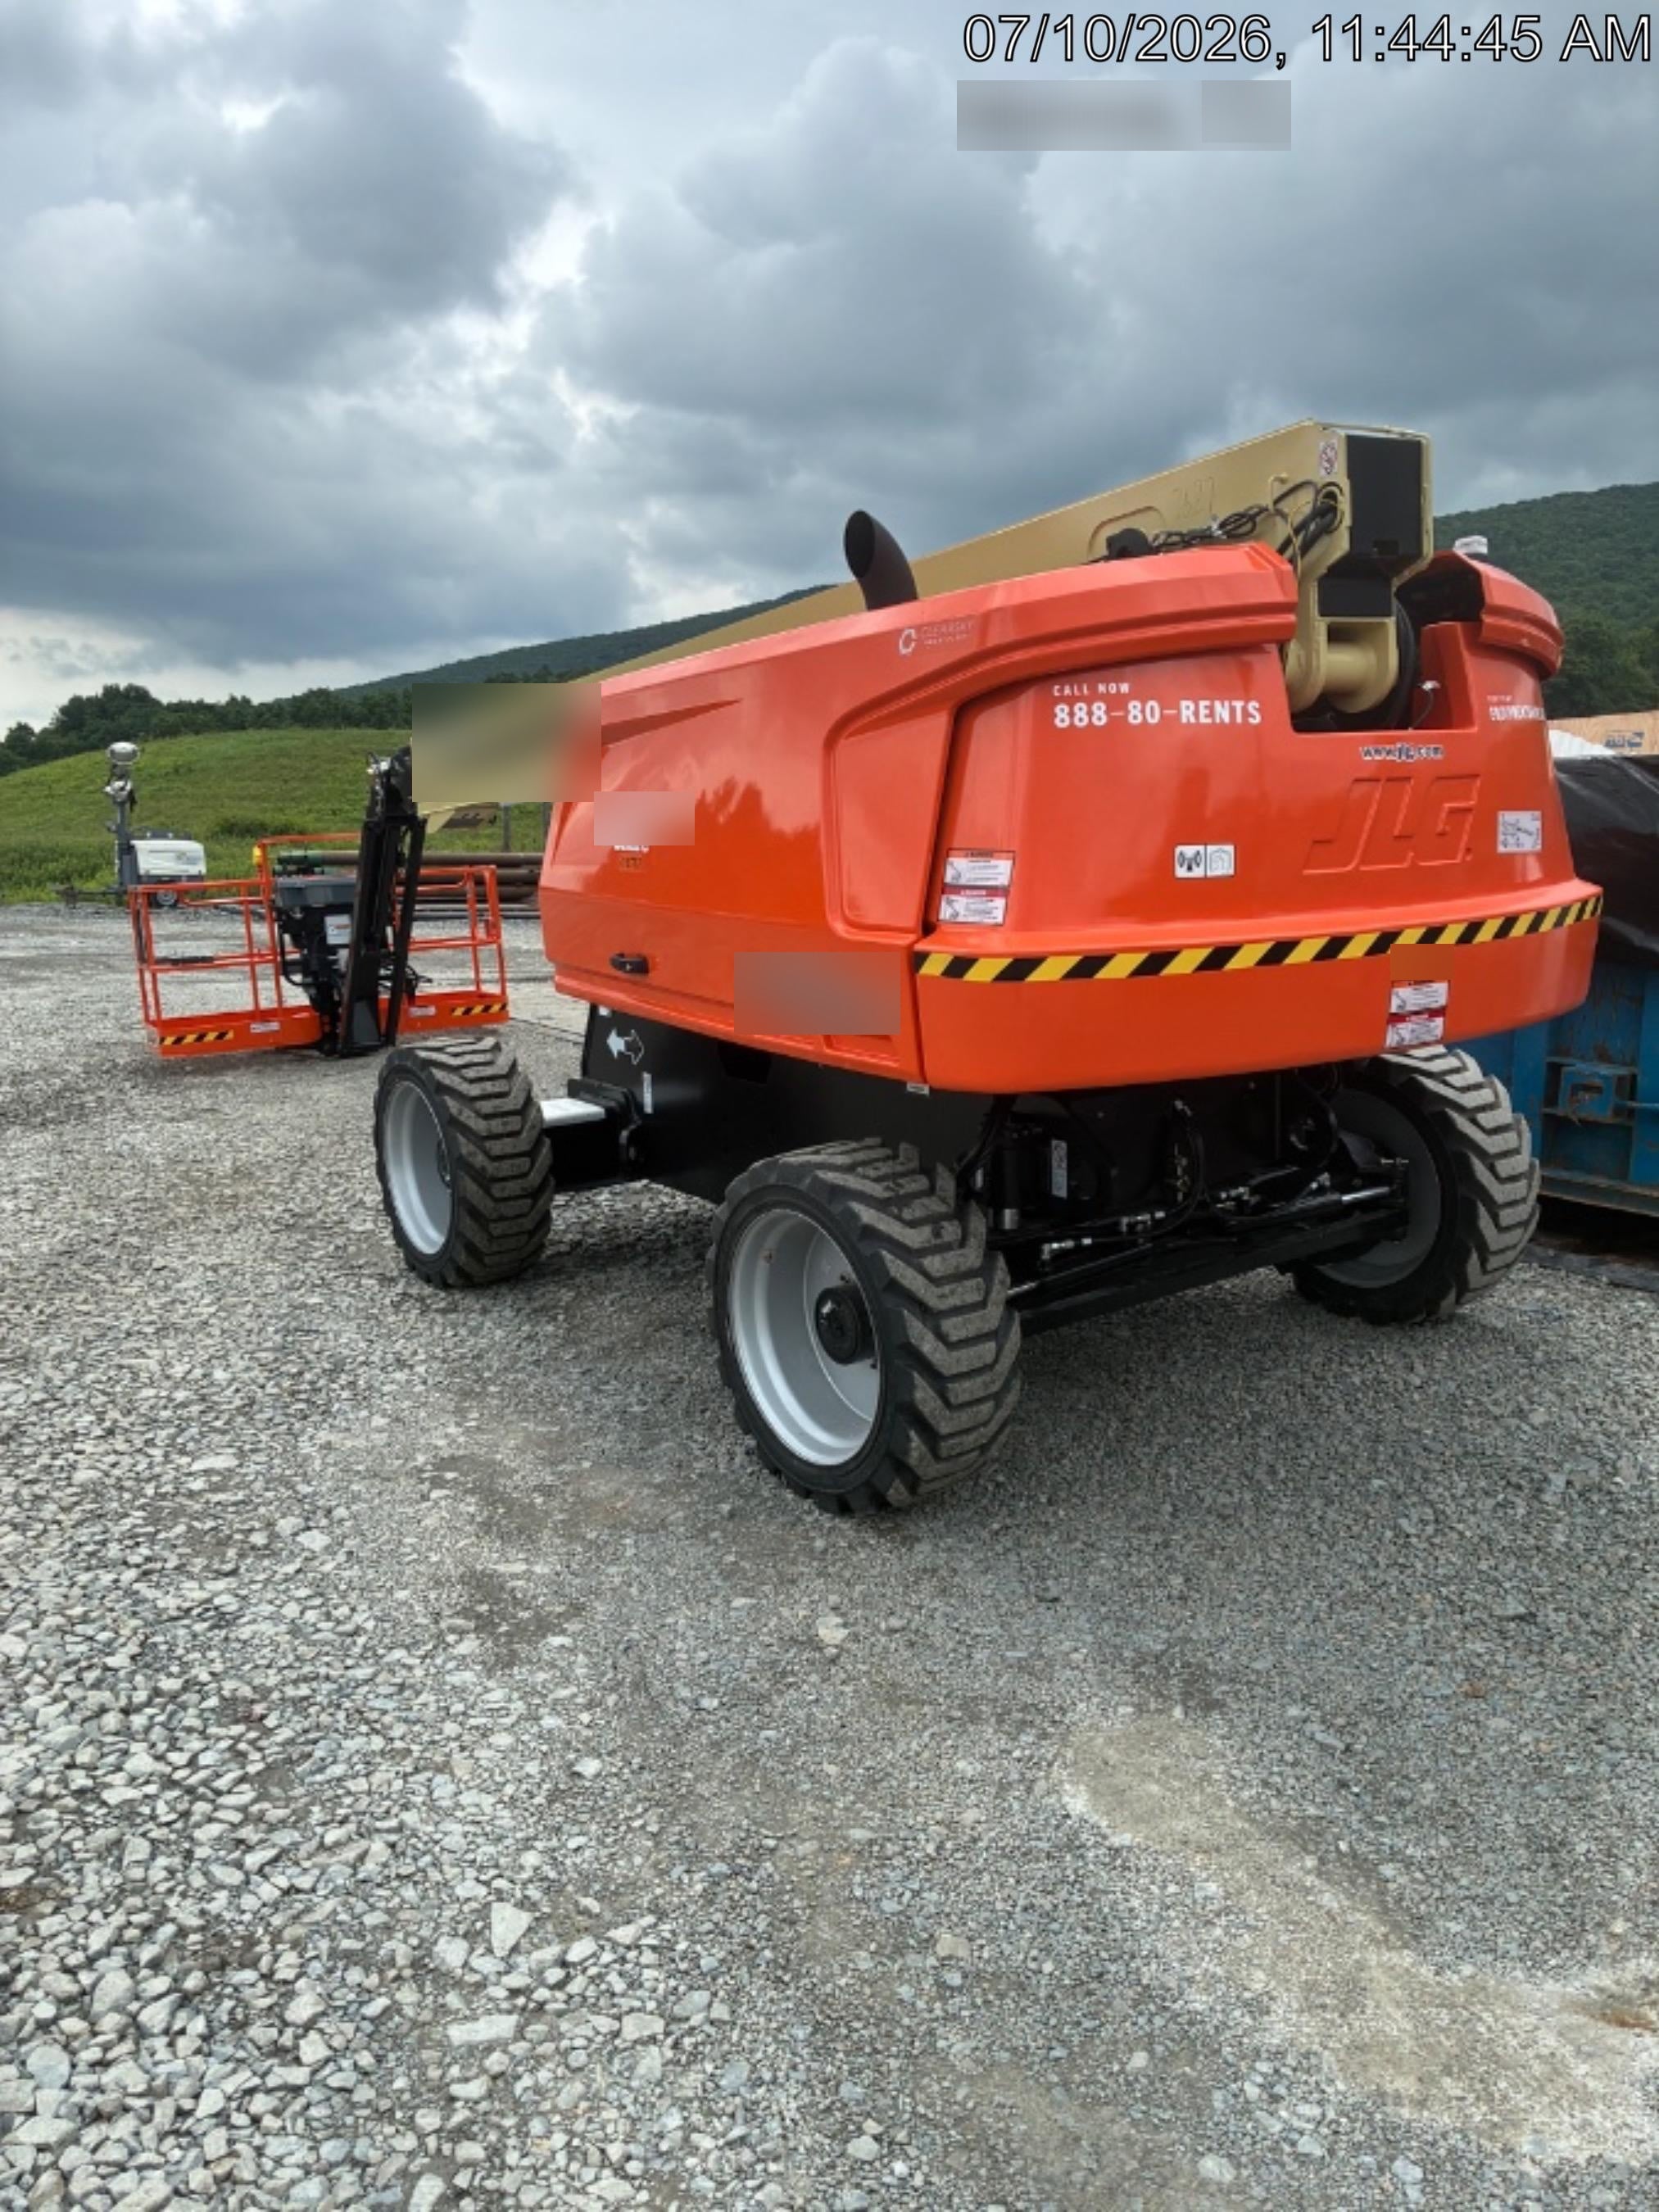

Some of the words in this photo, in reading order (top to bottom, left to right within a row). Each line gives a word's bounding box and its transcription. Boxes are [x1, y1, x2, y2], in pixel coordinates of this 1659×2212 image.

[1054, 685, 1090, 696] CALL
[1098, 682, 1130, 695] NOW
[1054, 700, 1262, 728] 888-80-RENTS
[1303, 775, 1481, 874] JLG
